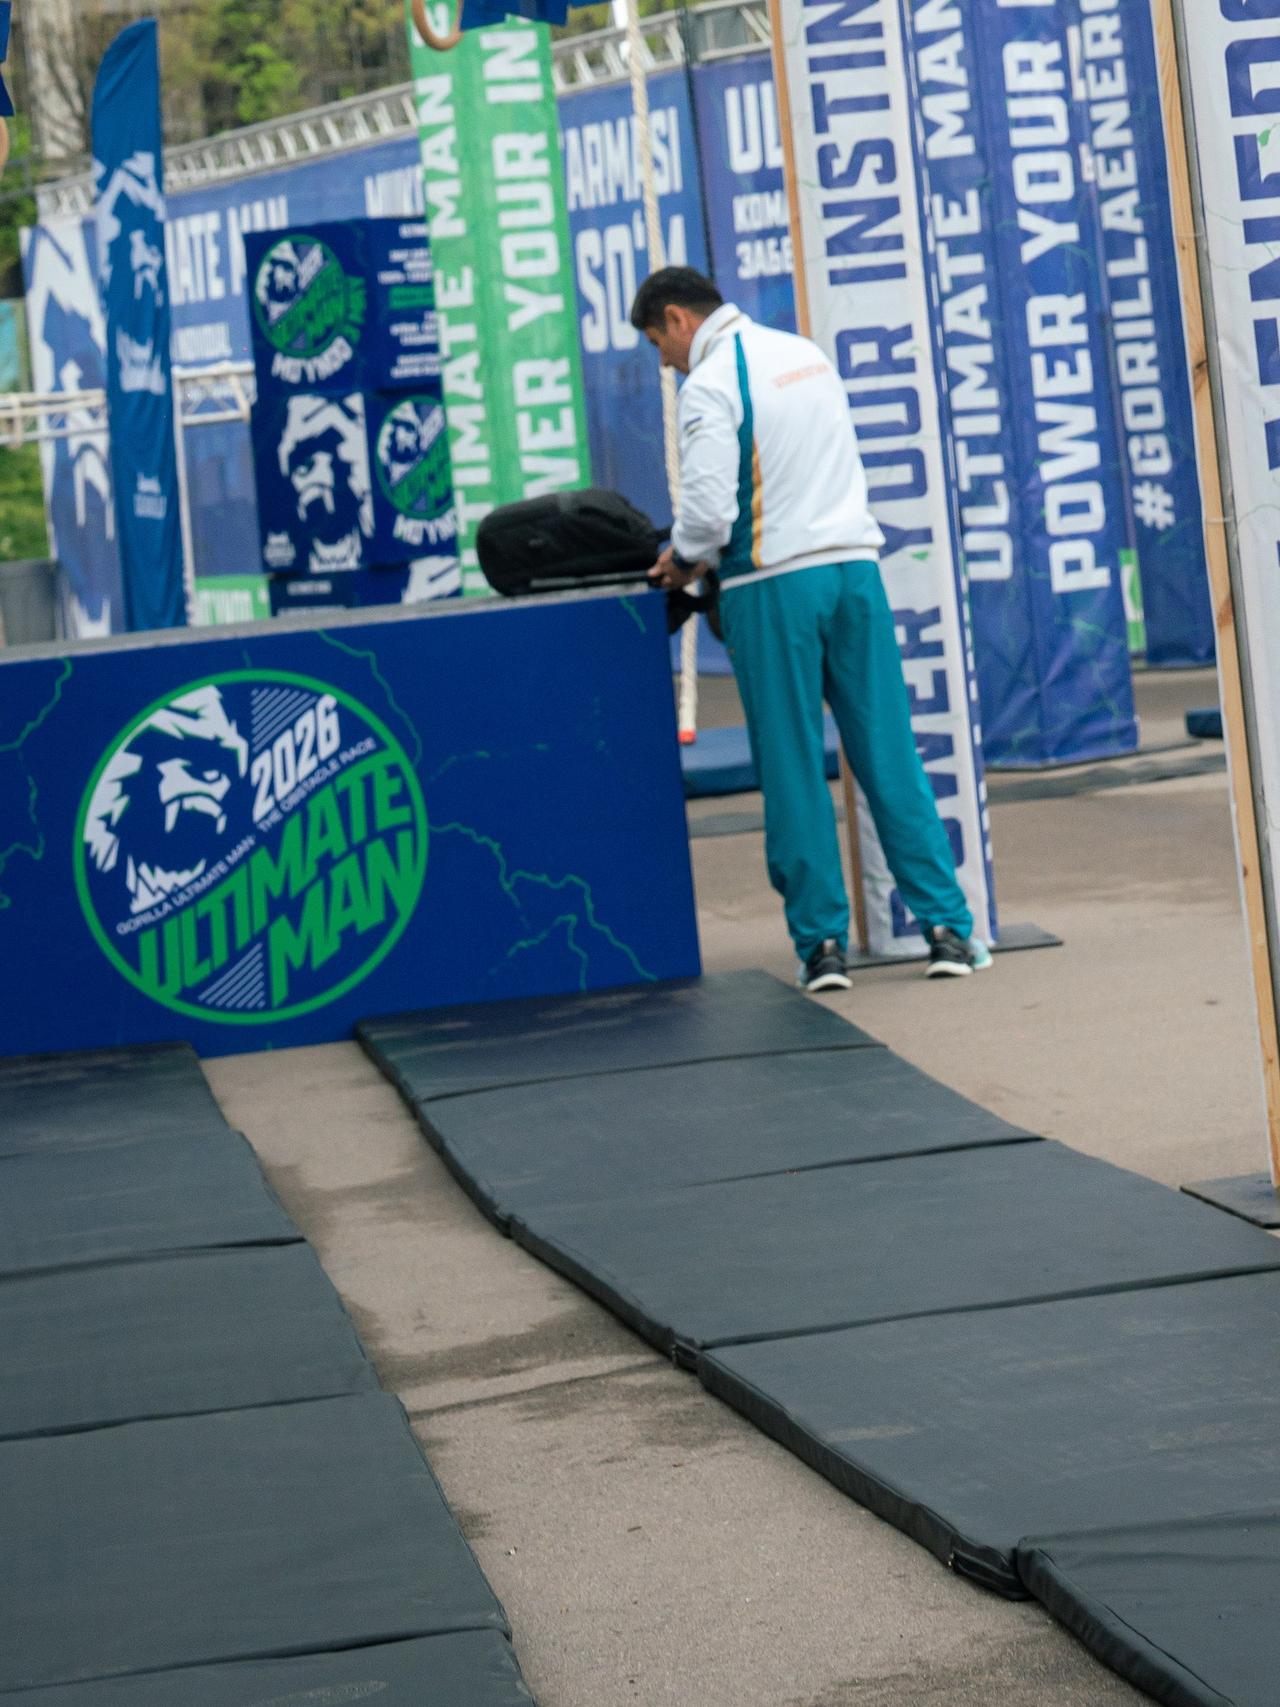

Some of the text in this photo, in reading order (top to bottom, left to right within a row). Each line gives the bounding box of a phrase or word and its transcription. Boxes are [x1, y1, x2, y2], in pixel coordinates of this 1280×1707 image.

[415, 72, 467, 239] MAN
[492, 131, 564, 332] YOUR
[1002, 40, 1080, 264] YOUR
[933, 189, 1013, 583] ULTIMATE
[1025, 292, 1111, 593] POWER
[251, 693, 341, 824] 2026
[256, 737, 377, 834] THE OBSTACLE RACE
[116, 835, 256, 936] GORILLA ULTIMATE MAN
[138, 760, 413, 1001] ULTIMATE
[268, 829, 418, 1010] MAN
